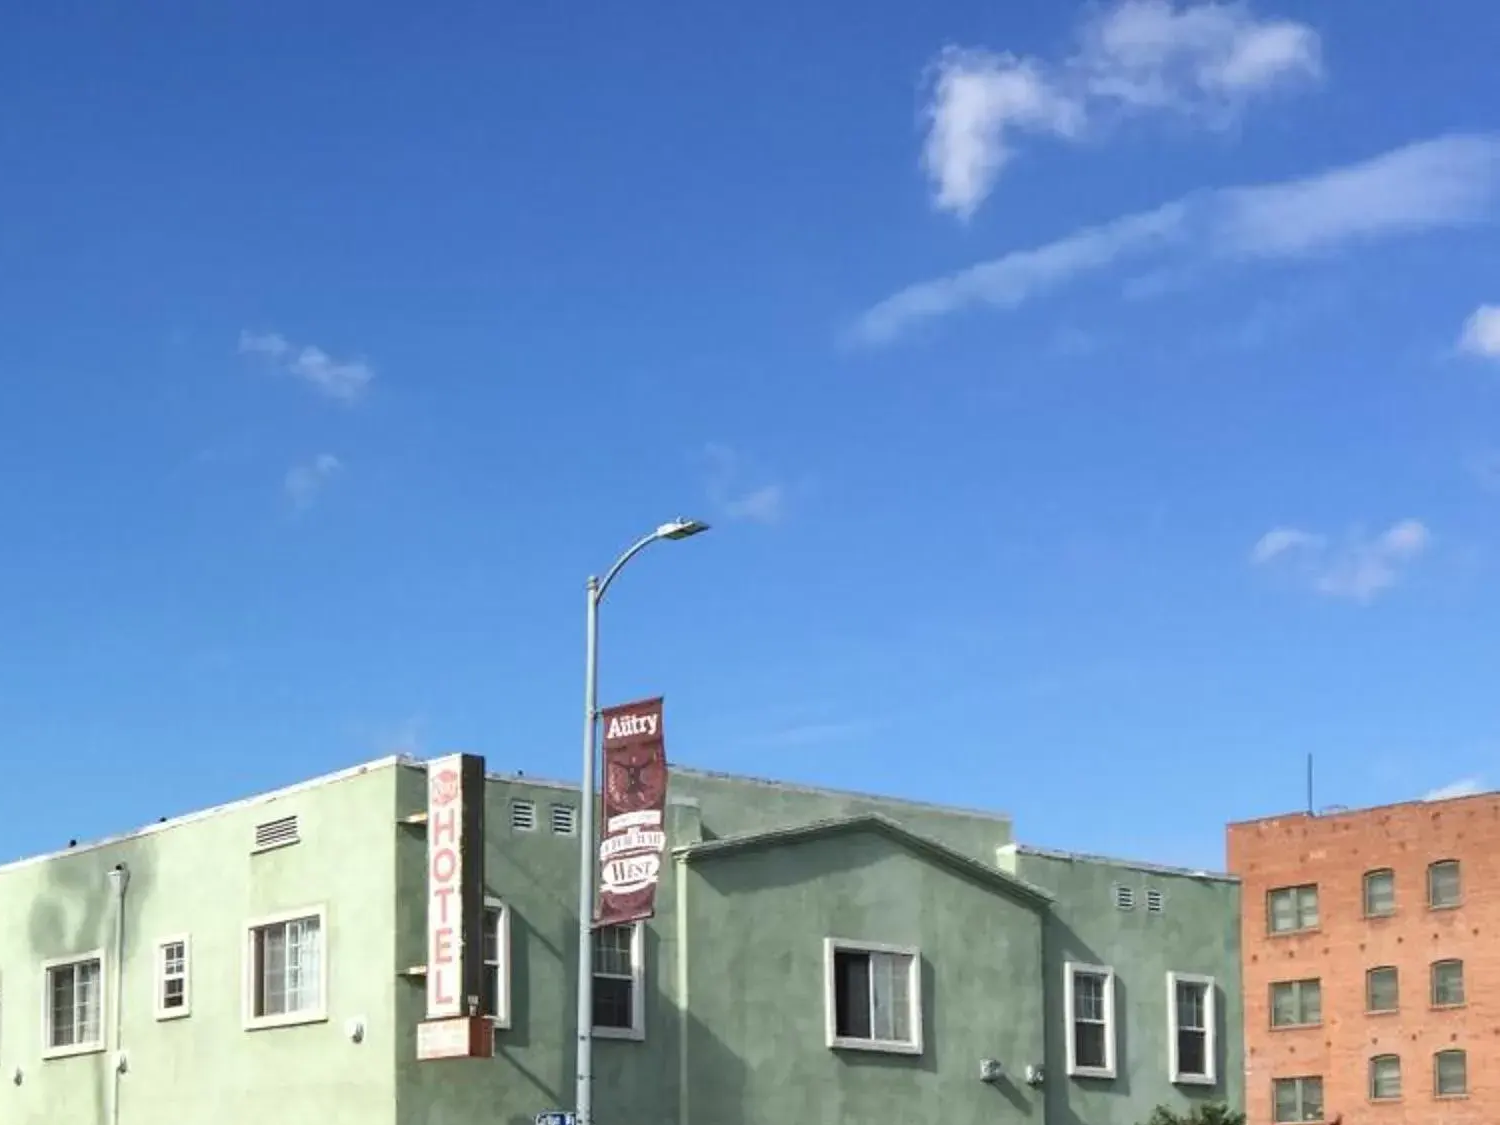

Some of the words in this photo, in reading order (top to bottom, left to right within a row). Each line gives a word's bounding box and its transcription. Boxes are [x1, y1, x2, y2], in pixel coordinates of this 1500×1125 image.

[607, 714, 658, 739] Autry
[611, 861, 653, 881] WEST
[433, 808, 457, 1005] HOTEL
